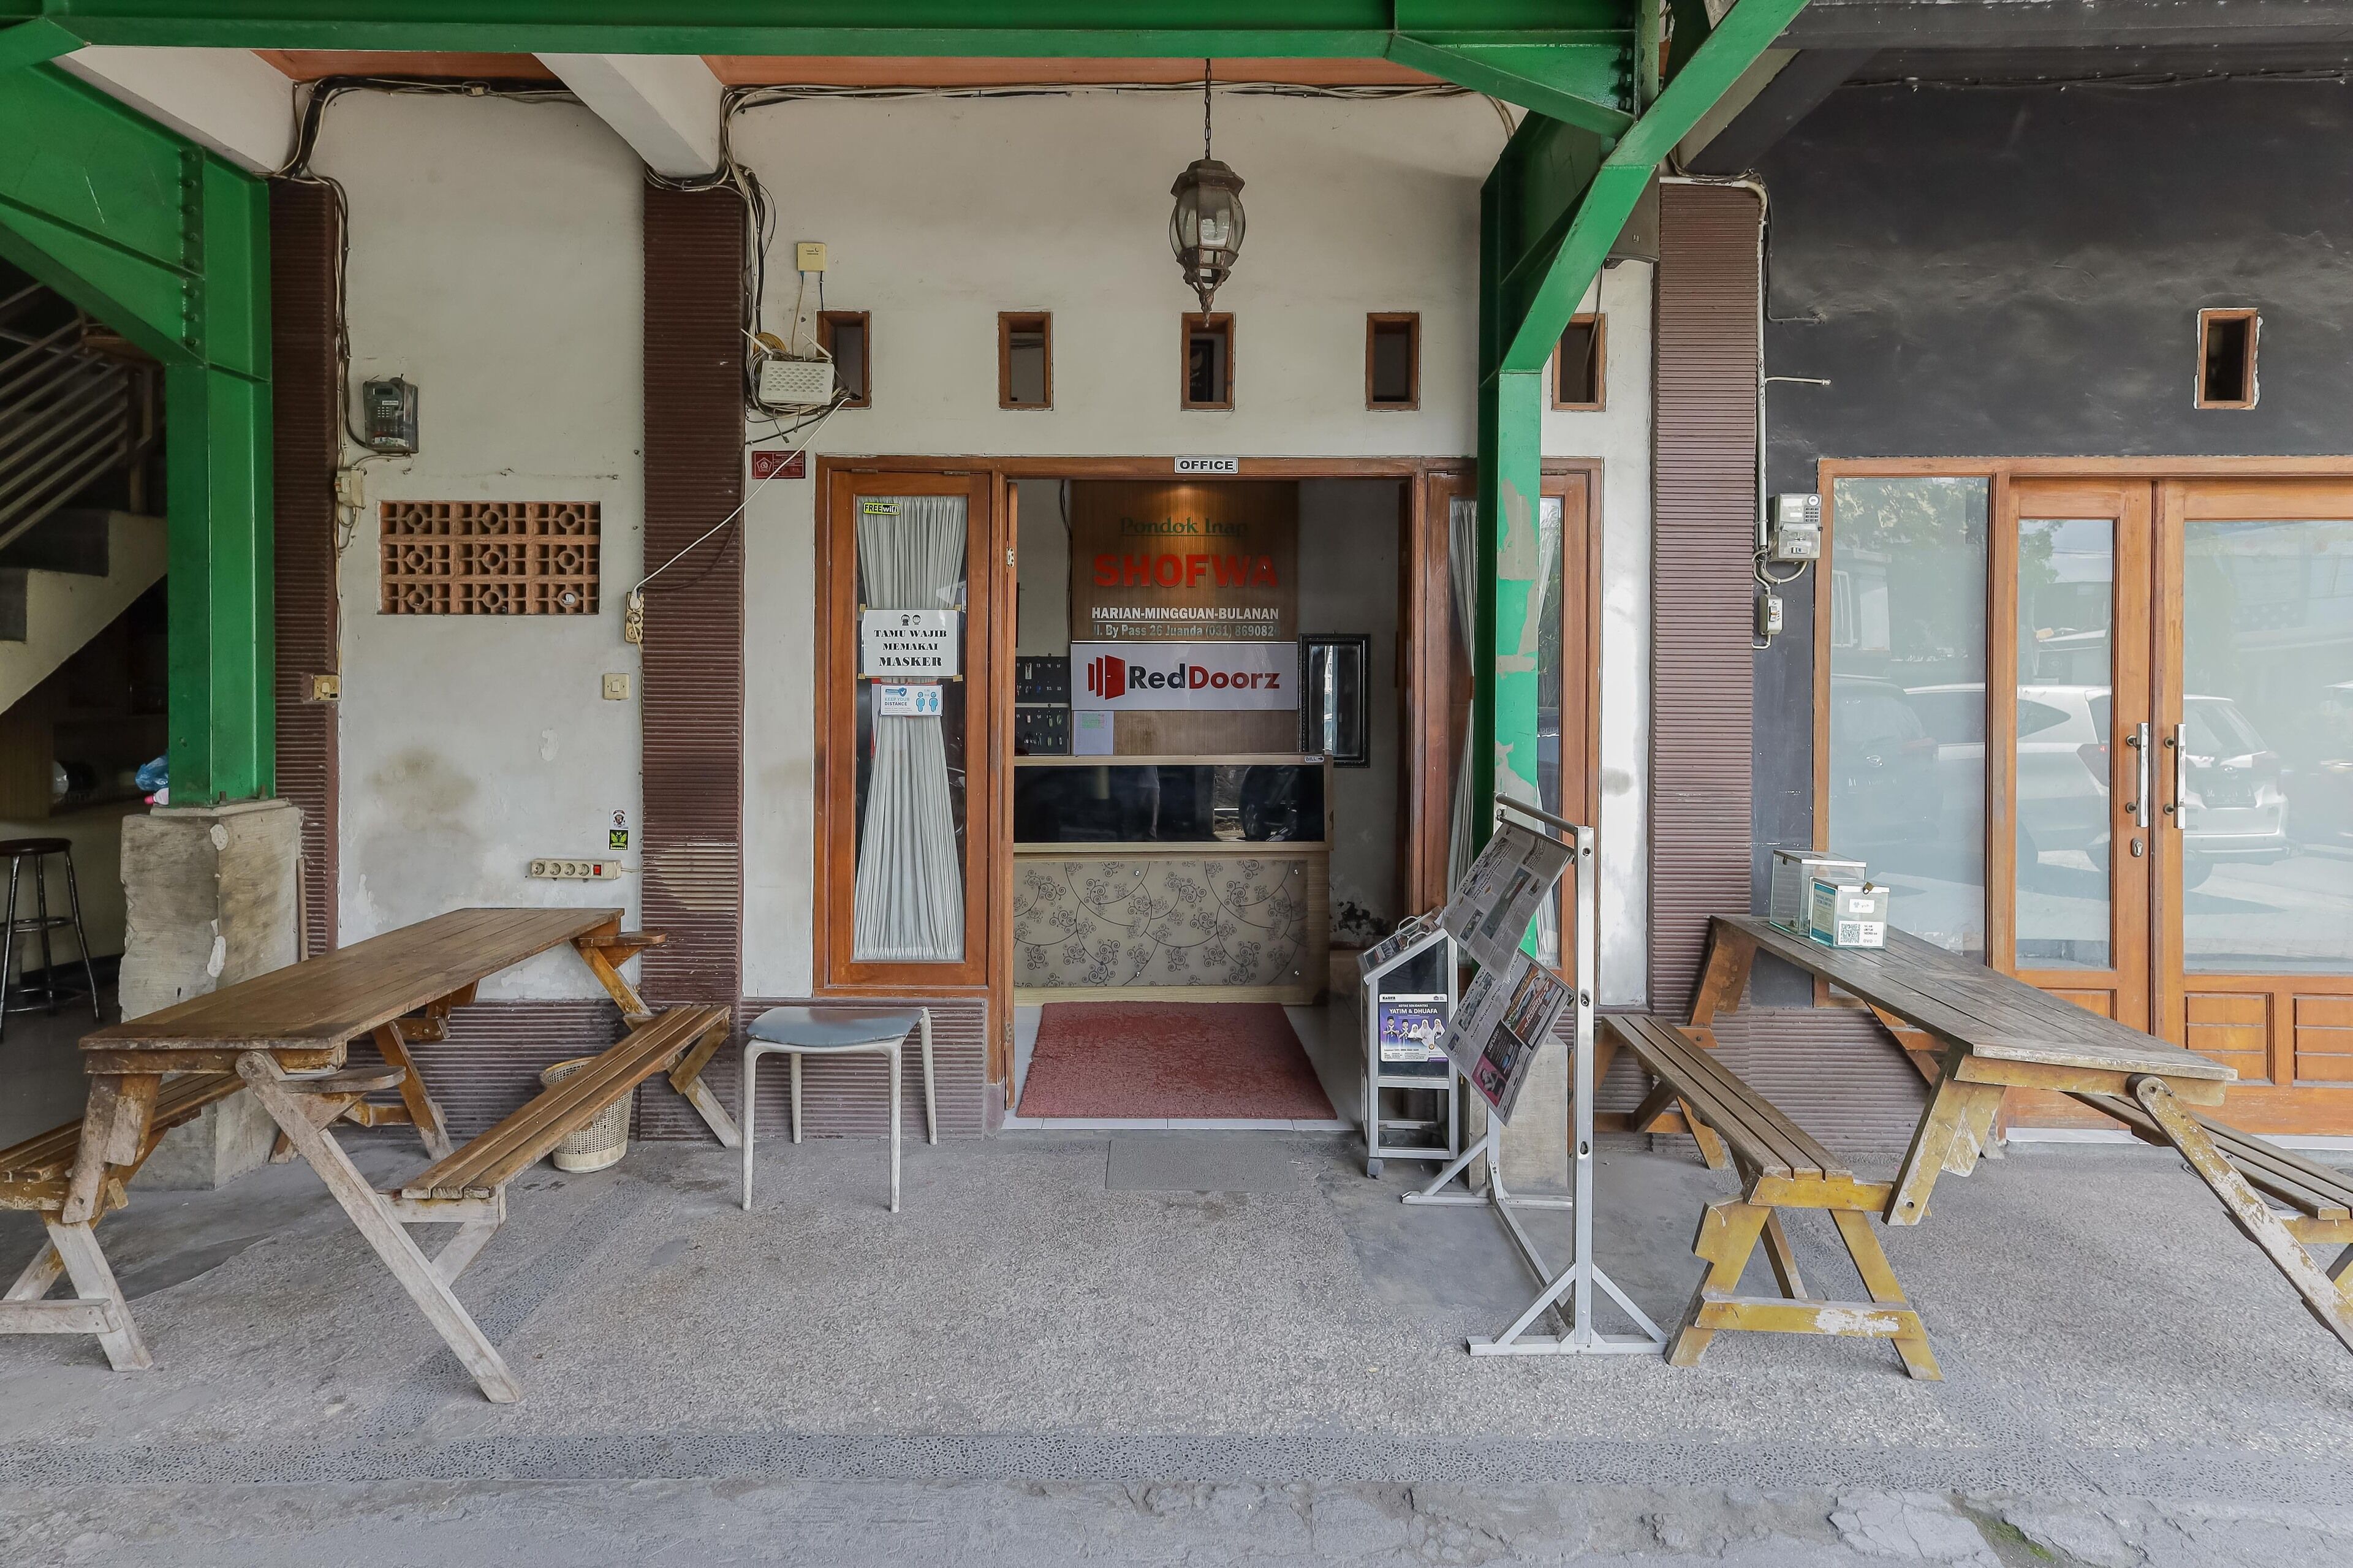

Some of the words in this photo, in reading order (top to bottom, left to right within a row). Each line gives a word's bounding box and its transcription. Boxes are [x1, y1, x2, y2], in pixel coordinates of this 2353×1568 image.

[1180, 460, 1233, 470] OFFICE
[1120, 517, 1199, 534] Pondok
[1205, 518, 1249, 537] Inap
[1093, 554, 1278, 588] SHOFWA
[1091, 607, 1279, 620] HARIAN-MINGGUAN-BULANAN
[1105, 624, 1119, 638] By
[1121, 624, 1147, 636] Pass
[1150, 624, 1162, 636] 26
[1165, 624, 1203, 636] Juanda
[1205, 625, 1232, 638] (031)
[879, 656, 942, 666] MASKER
[1129, 663, 1280, 689] RedDoorz
